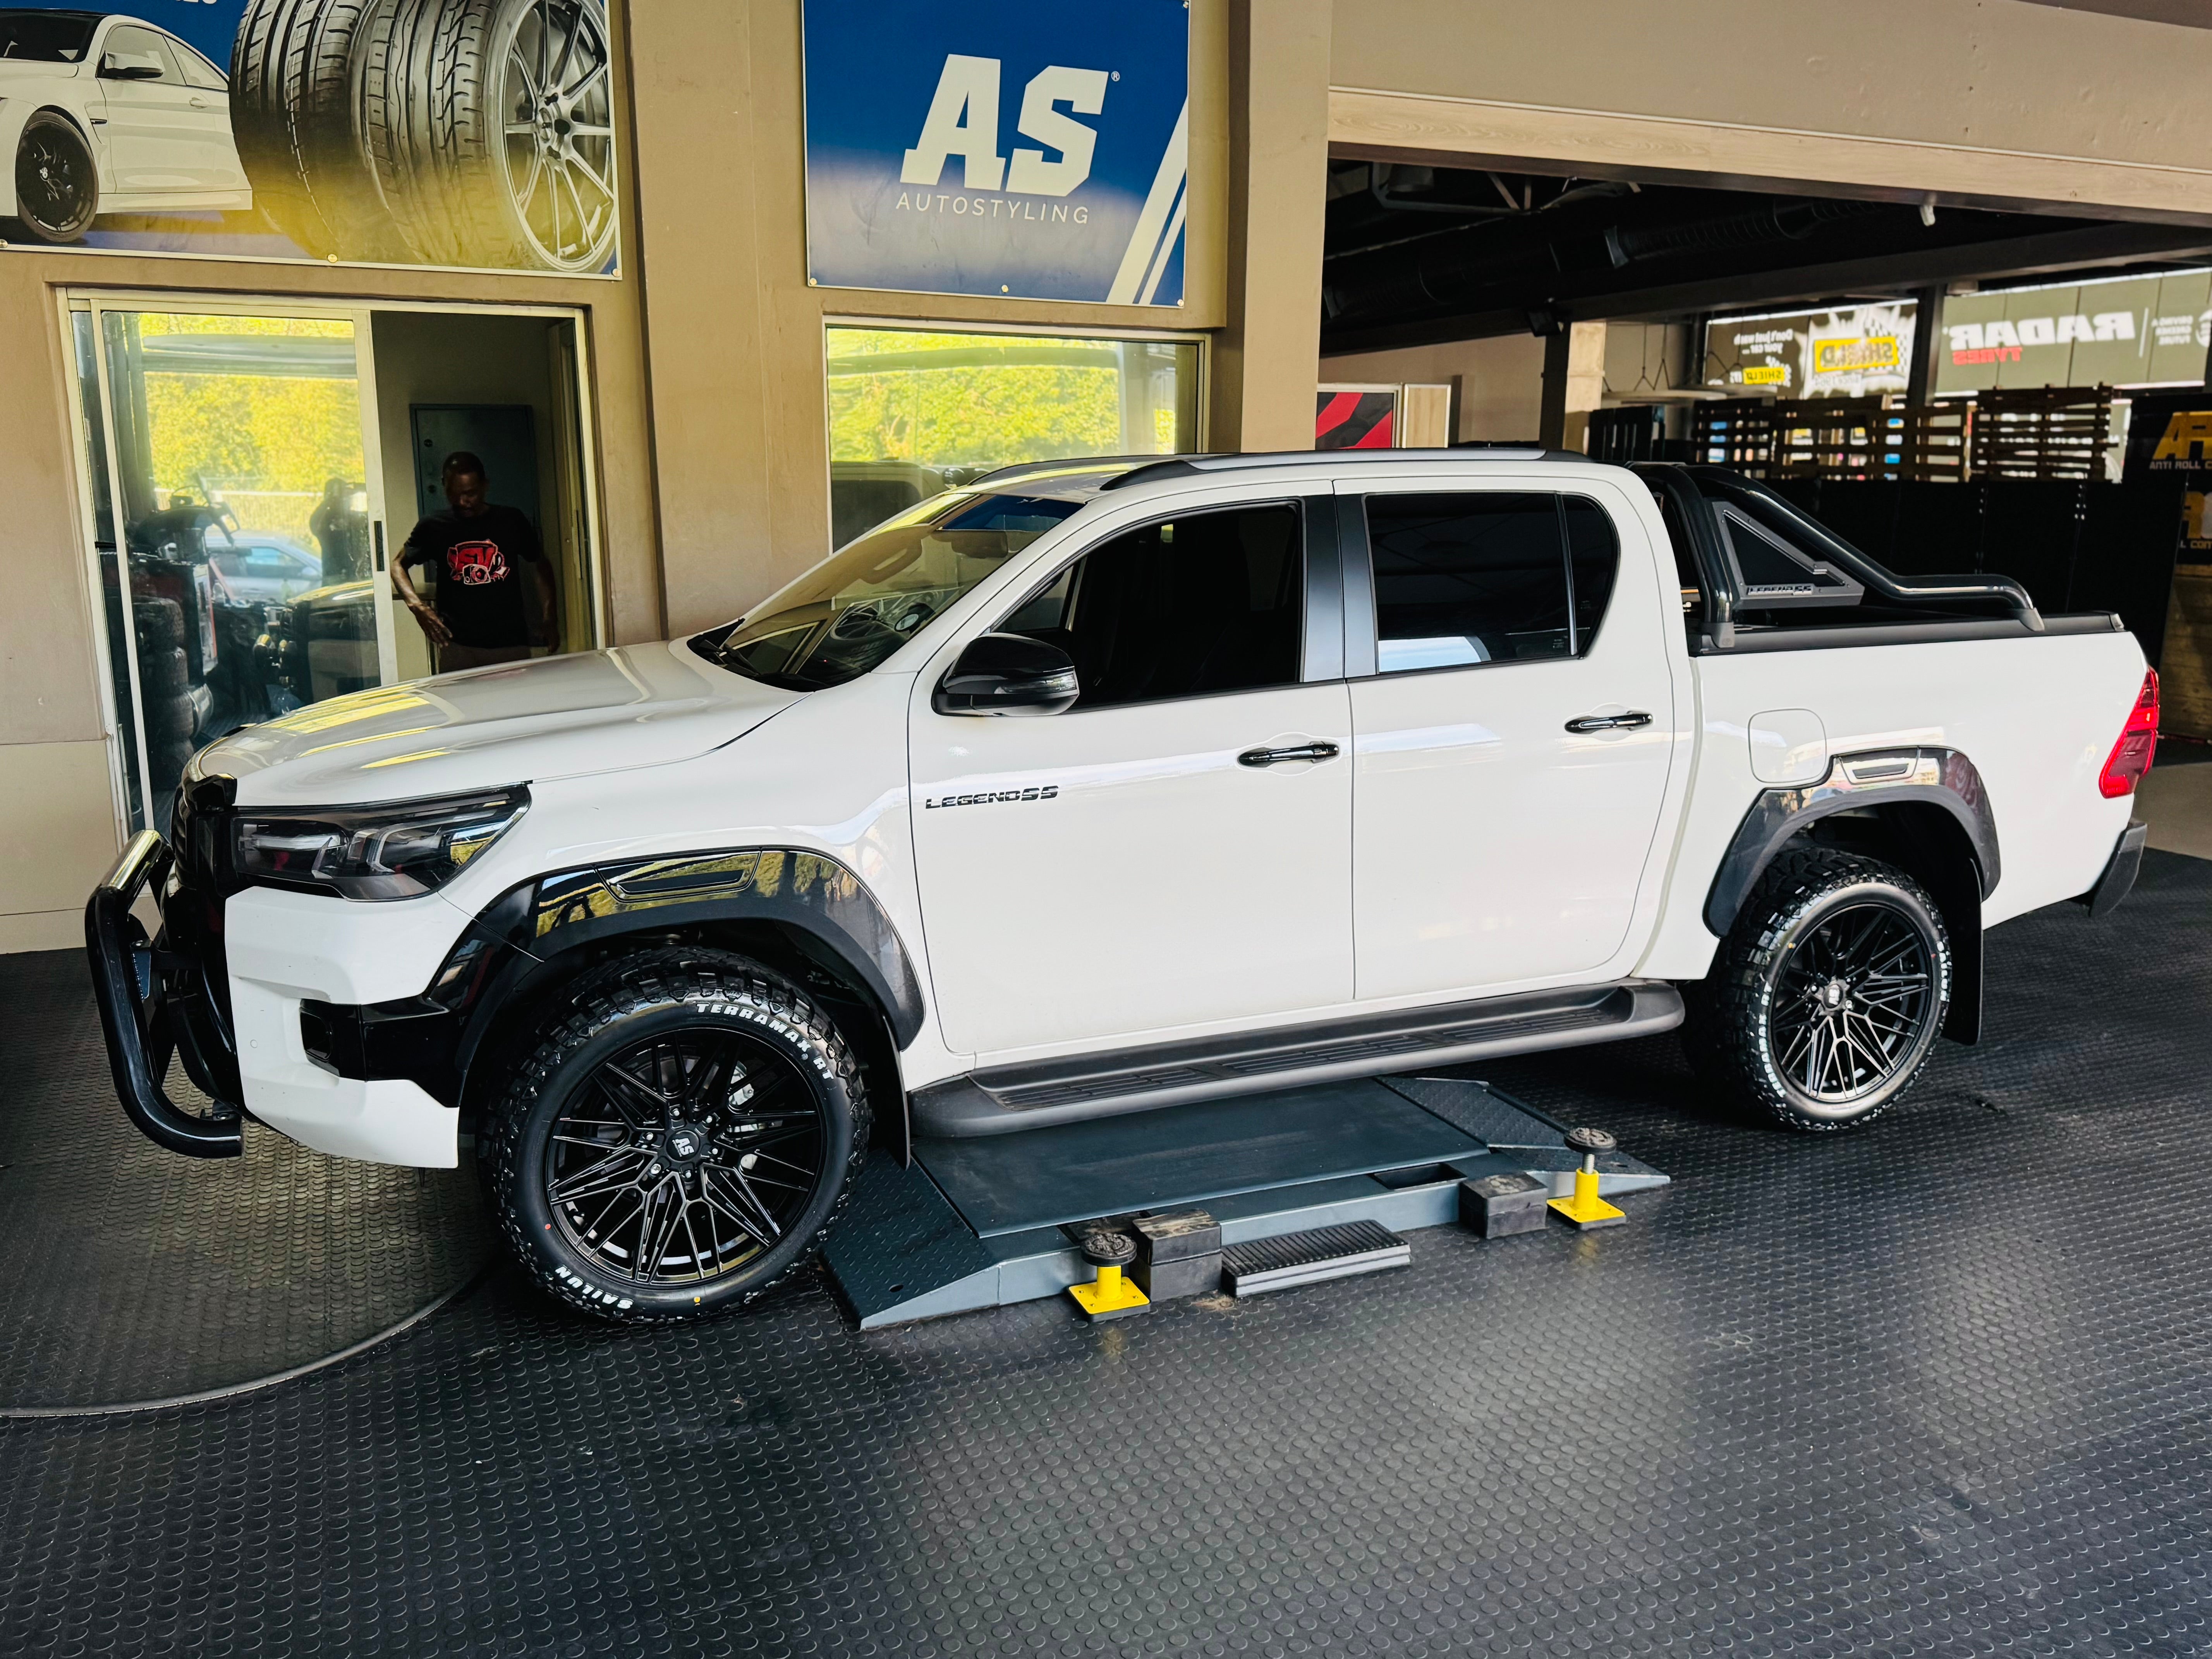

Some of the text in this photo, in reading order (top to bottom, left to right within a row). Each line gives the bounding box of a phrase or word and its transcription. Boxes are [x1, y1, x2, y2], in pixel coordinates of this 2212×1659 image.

[900, 53, 1109, 197] AS
[896, 192, 1089, 224] AUTOSTYLING
[2175, 460, 2201, 469] ROLL
[696, 1002, 834, 1080] TERRAMAX RT
[555, 1265, 634, 1310] SAILUN
